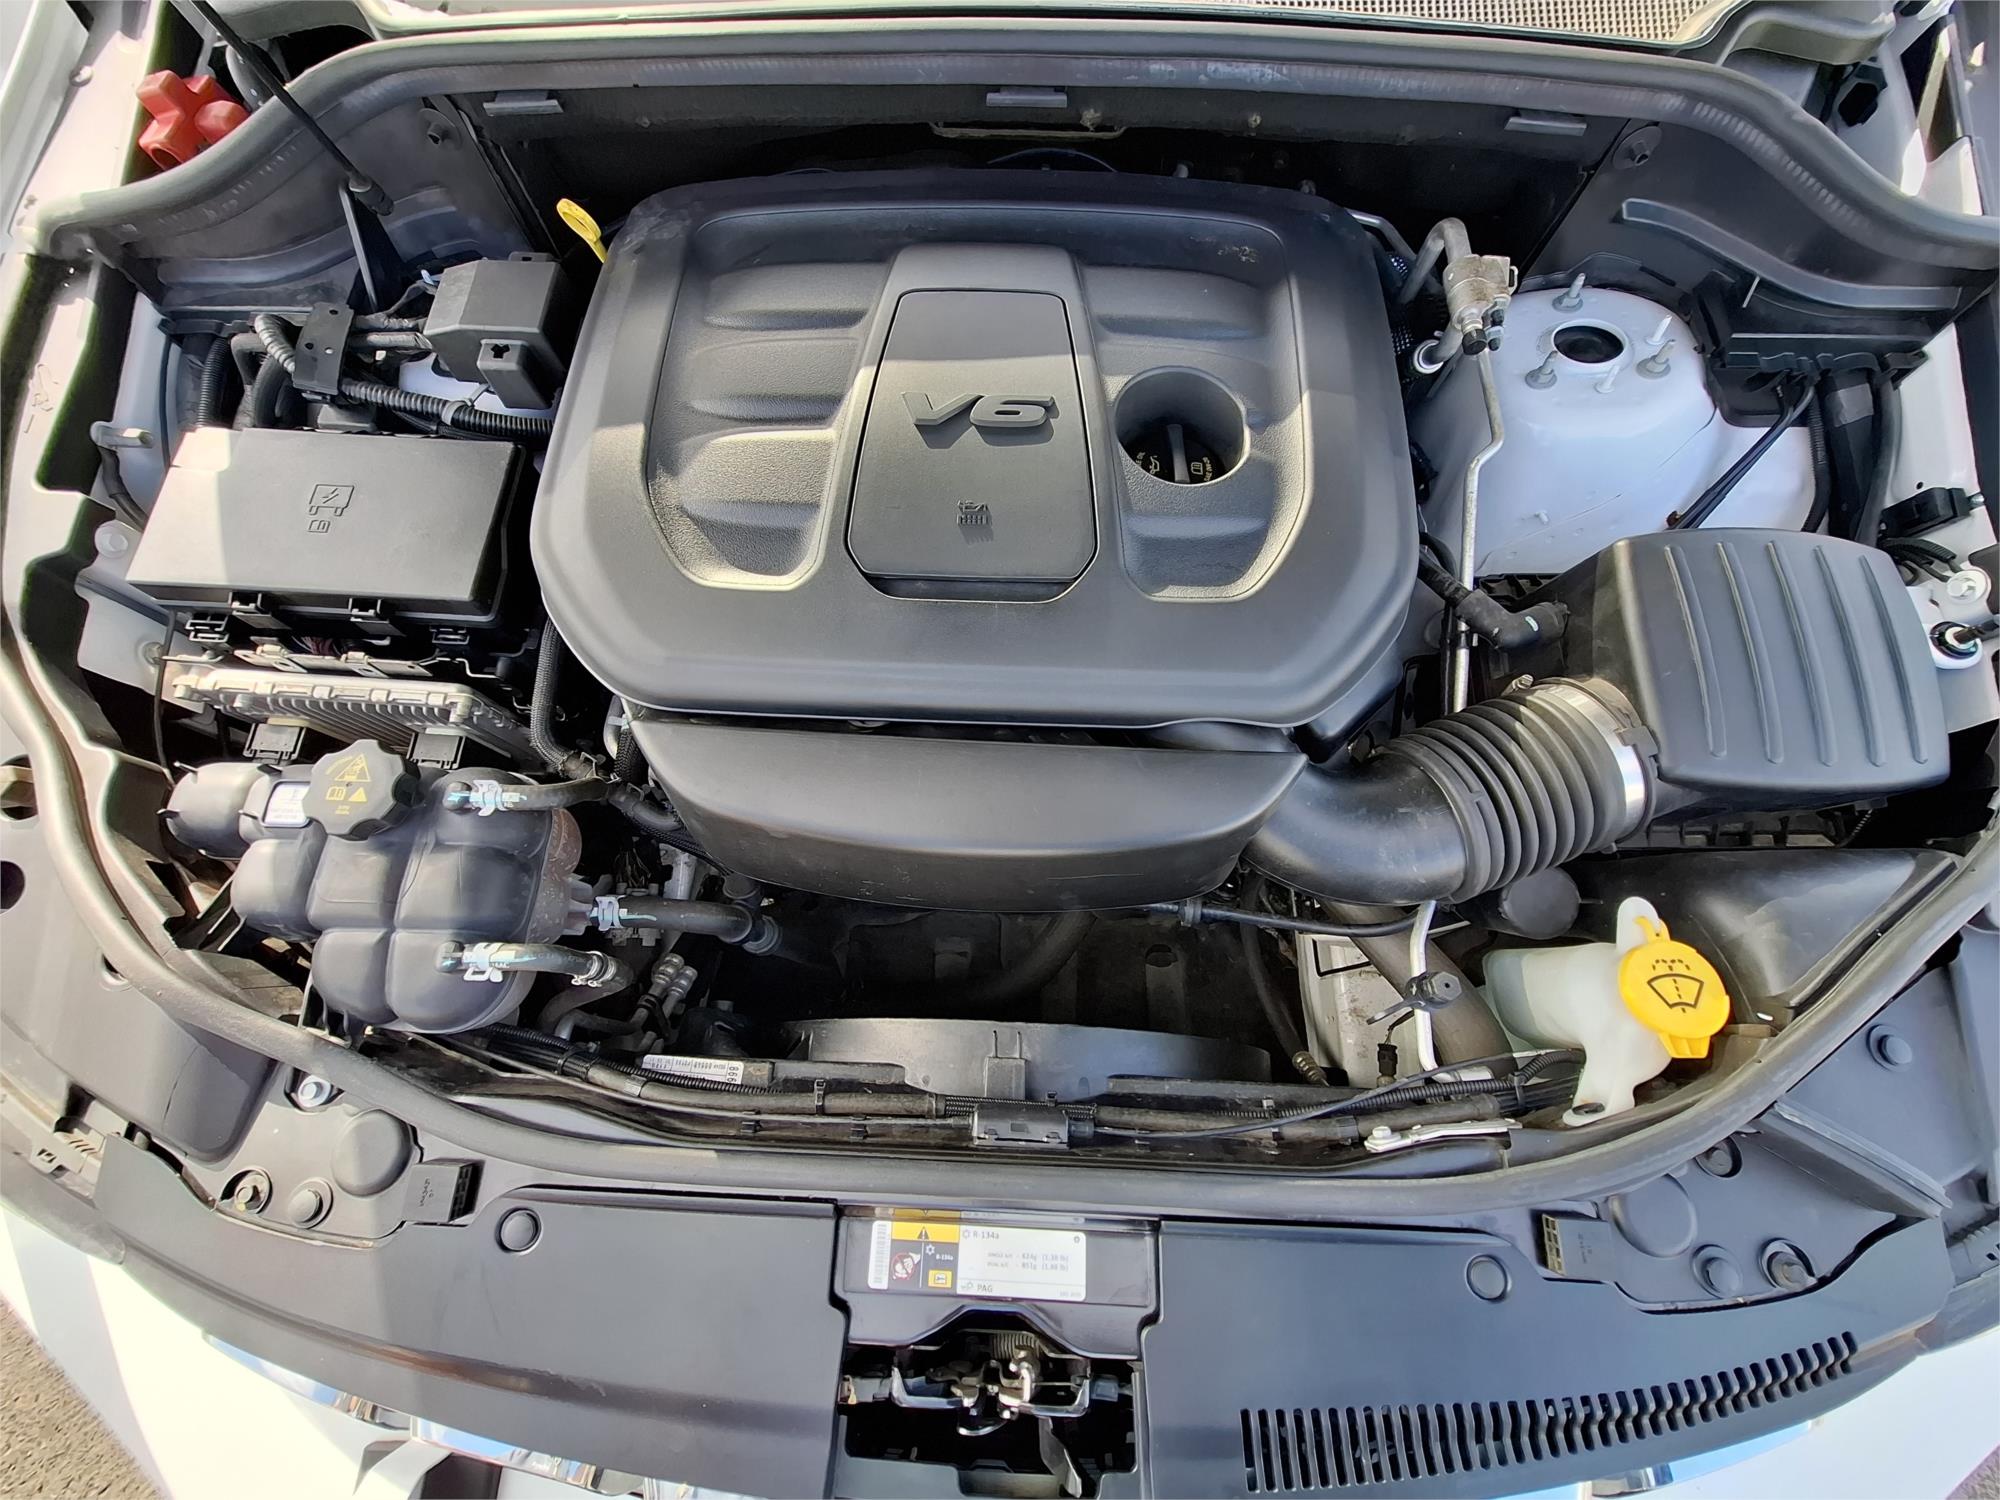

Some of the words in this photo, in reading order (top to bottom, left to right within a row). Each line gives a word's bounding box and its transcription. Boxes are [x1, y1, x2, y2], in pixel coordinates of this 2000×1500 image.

[902, 392, 1055, 427] V6
[973, 1231, 999, 1240] R-134a
[977, 1285, 993, 1293] PAG
